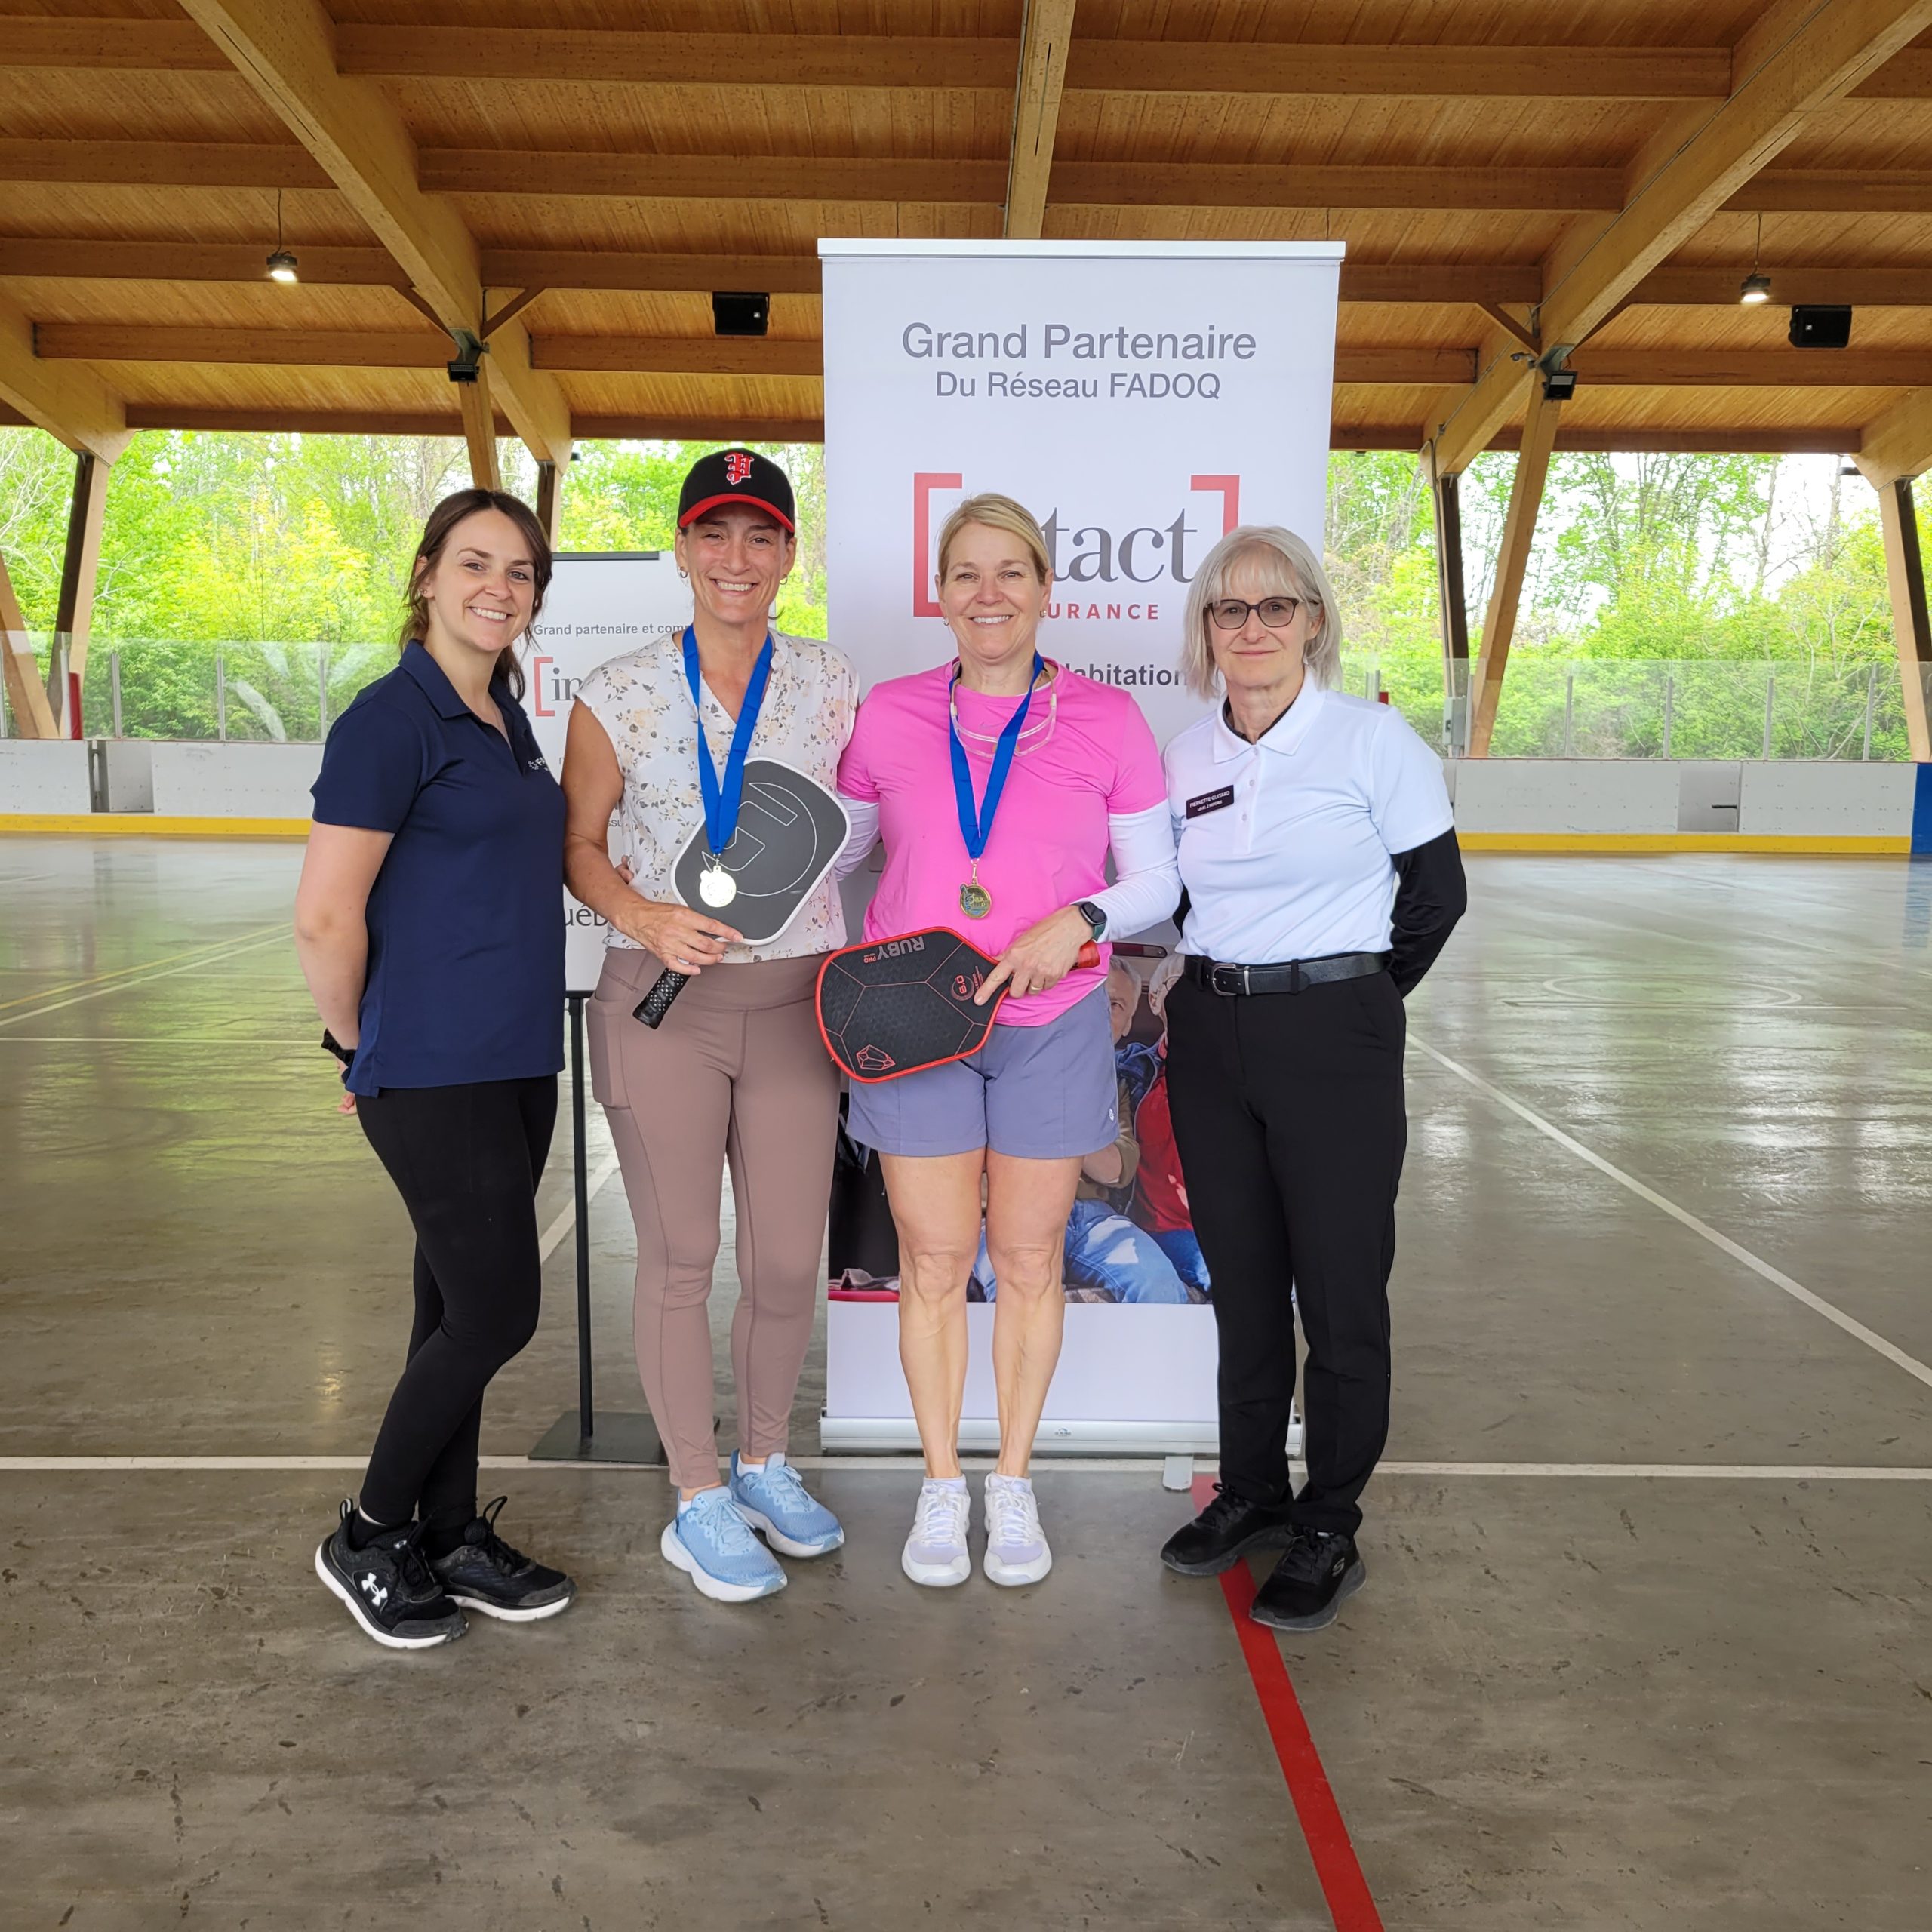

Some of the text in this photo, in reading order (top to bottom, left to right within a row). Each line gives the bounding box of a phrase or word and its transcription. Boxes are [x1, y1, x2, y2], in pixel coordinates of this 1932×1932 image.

[902, 322, 1257, 360] Grand Partenaire
[937, 371, 1220, 400] Du Réseau FADOQ
[1040, 506, 1198, 583] tact
[1048, 603, 1159, 620] URANCE
[534, 623, 571, 635] Grand
[575, 623, 638, 638] partenaire
[641, 623, 654, 634] et
[550, 667, 583, 701] in
[863, 936, 925, 964] RUBY PRO
